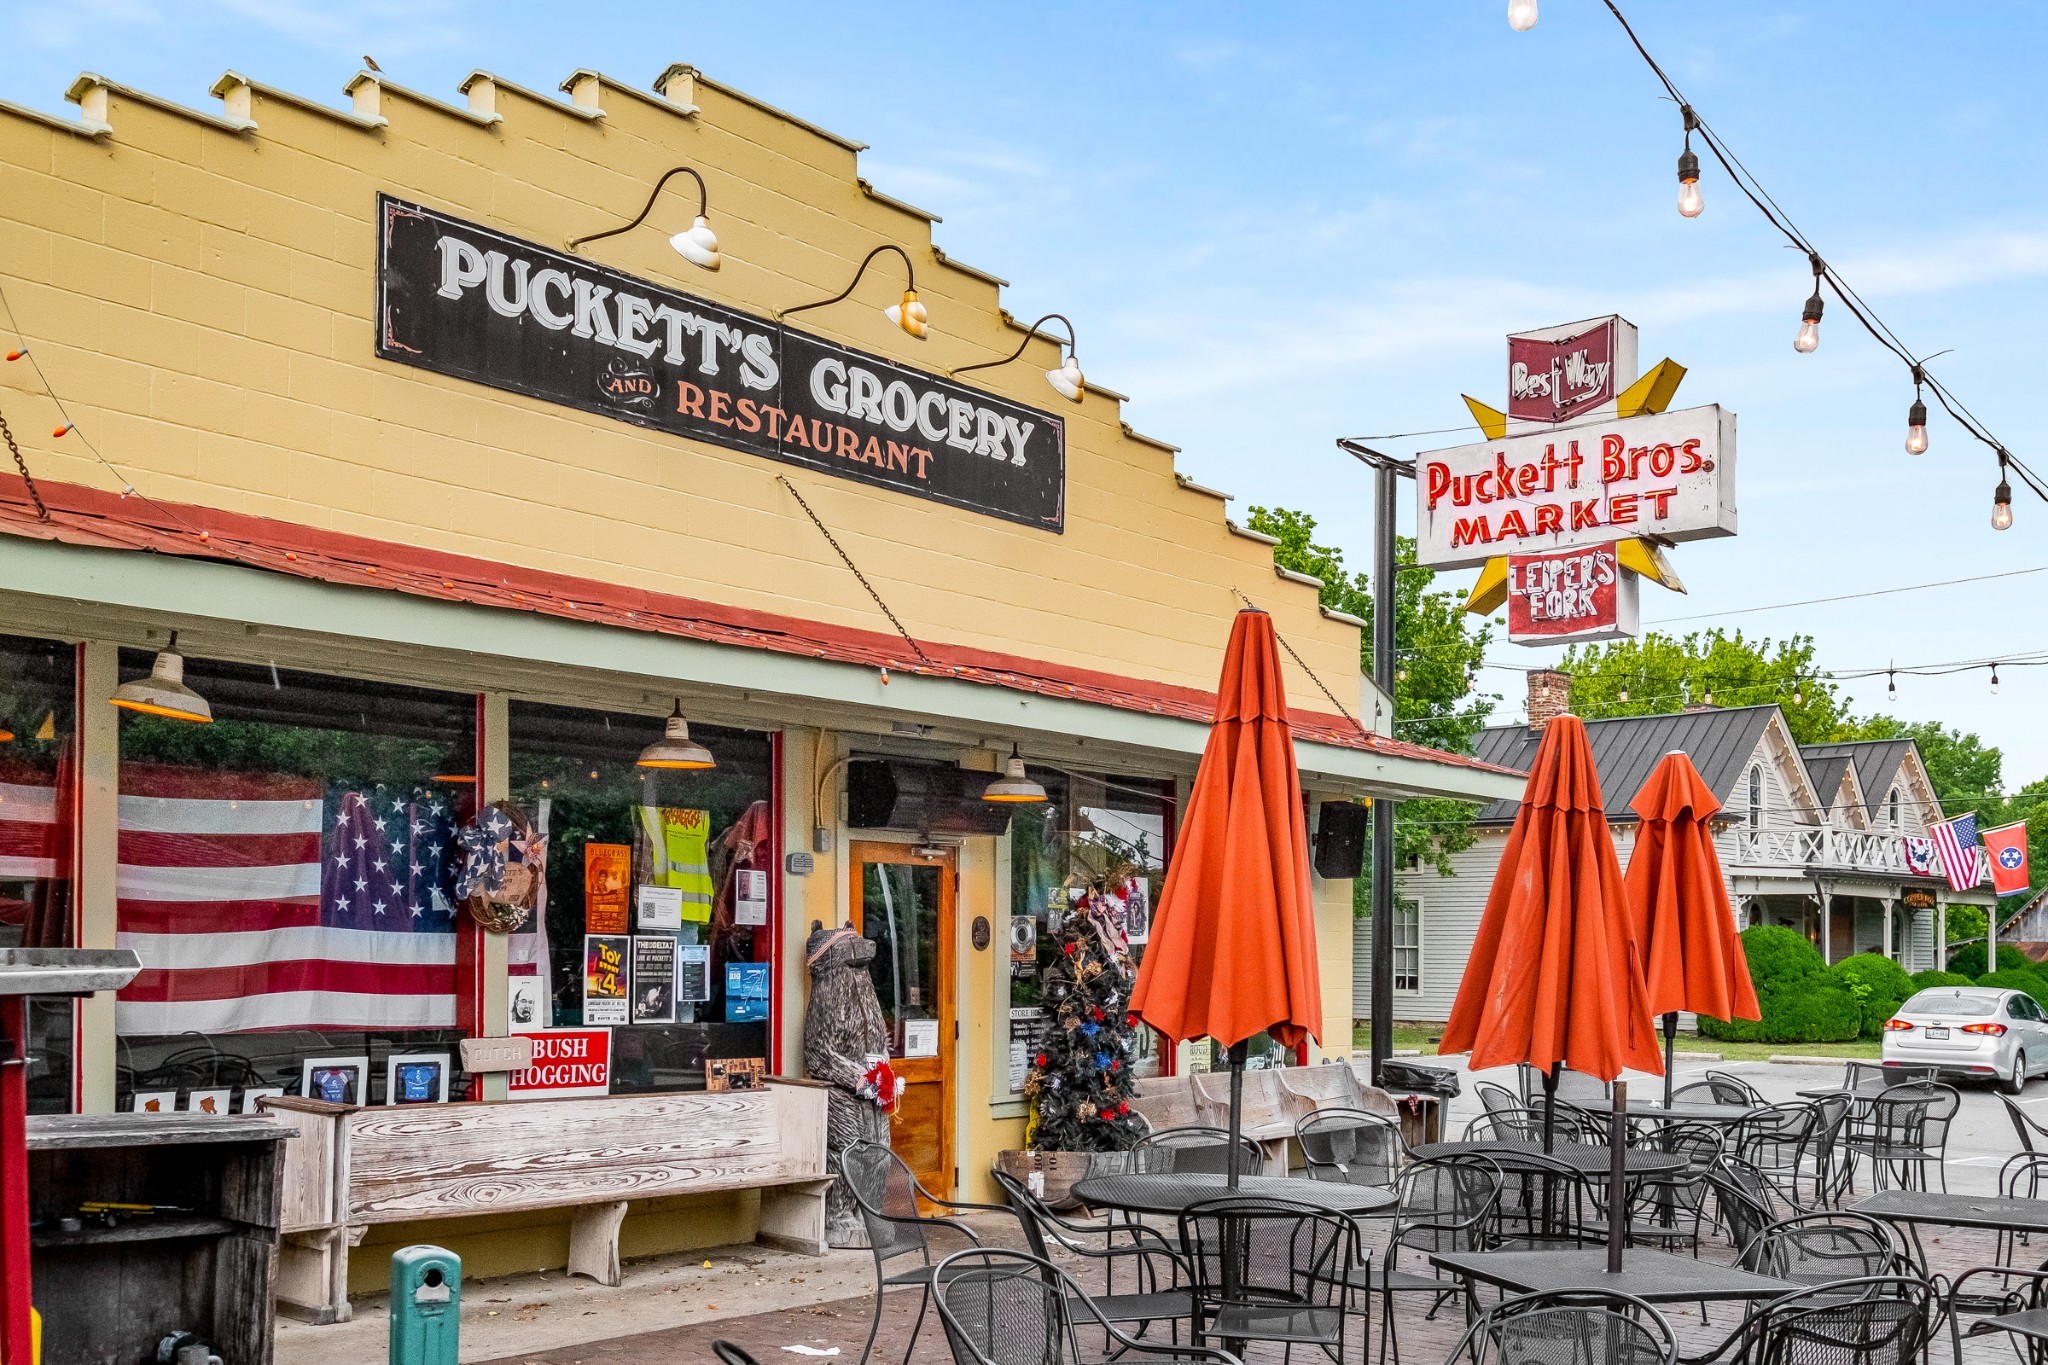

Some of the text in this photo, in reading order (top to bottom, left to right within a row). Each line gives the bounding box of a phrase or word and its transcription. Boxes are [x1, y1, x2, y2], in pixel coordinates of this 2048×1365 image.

[437, 235, 1036, 467] PUCKETT'S GROCERY
[1511, 348, 1611, 404] Best Way
[606, 378, 934, 480] AND RESTAURANT
[1426, 433, 1716, 512] Puckett Bros.
[1451, 486, 1678, 549] MARKET
[1510, 550, 1616, 597] LEIPER'S
[1530, 586, 1599, 622] FORK
[590, 847, 628, 858] BLUEGRASS
[598, 943, 622, 966] TOY
[598, 961, 620, 974] STORY
[602, 972, 617, 995] 4
[1011, 1009, 1029, 1018] STORE
[532, 1037, 589, 1059] BUSH
[510, 1062, 607, 1087] HOGGING
